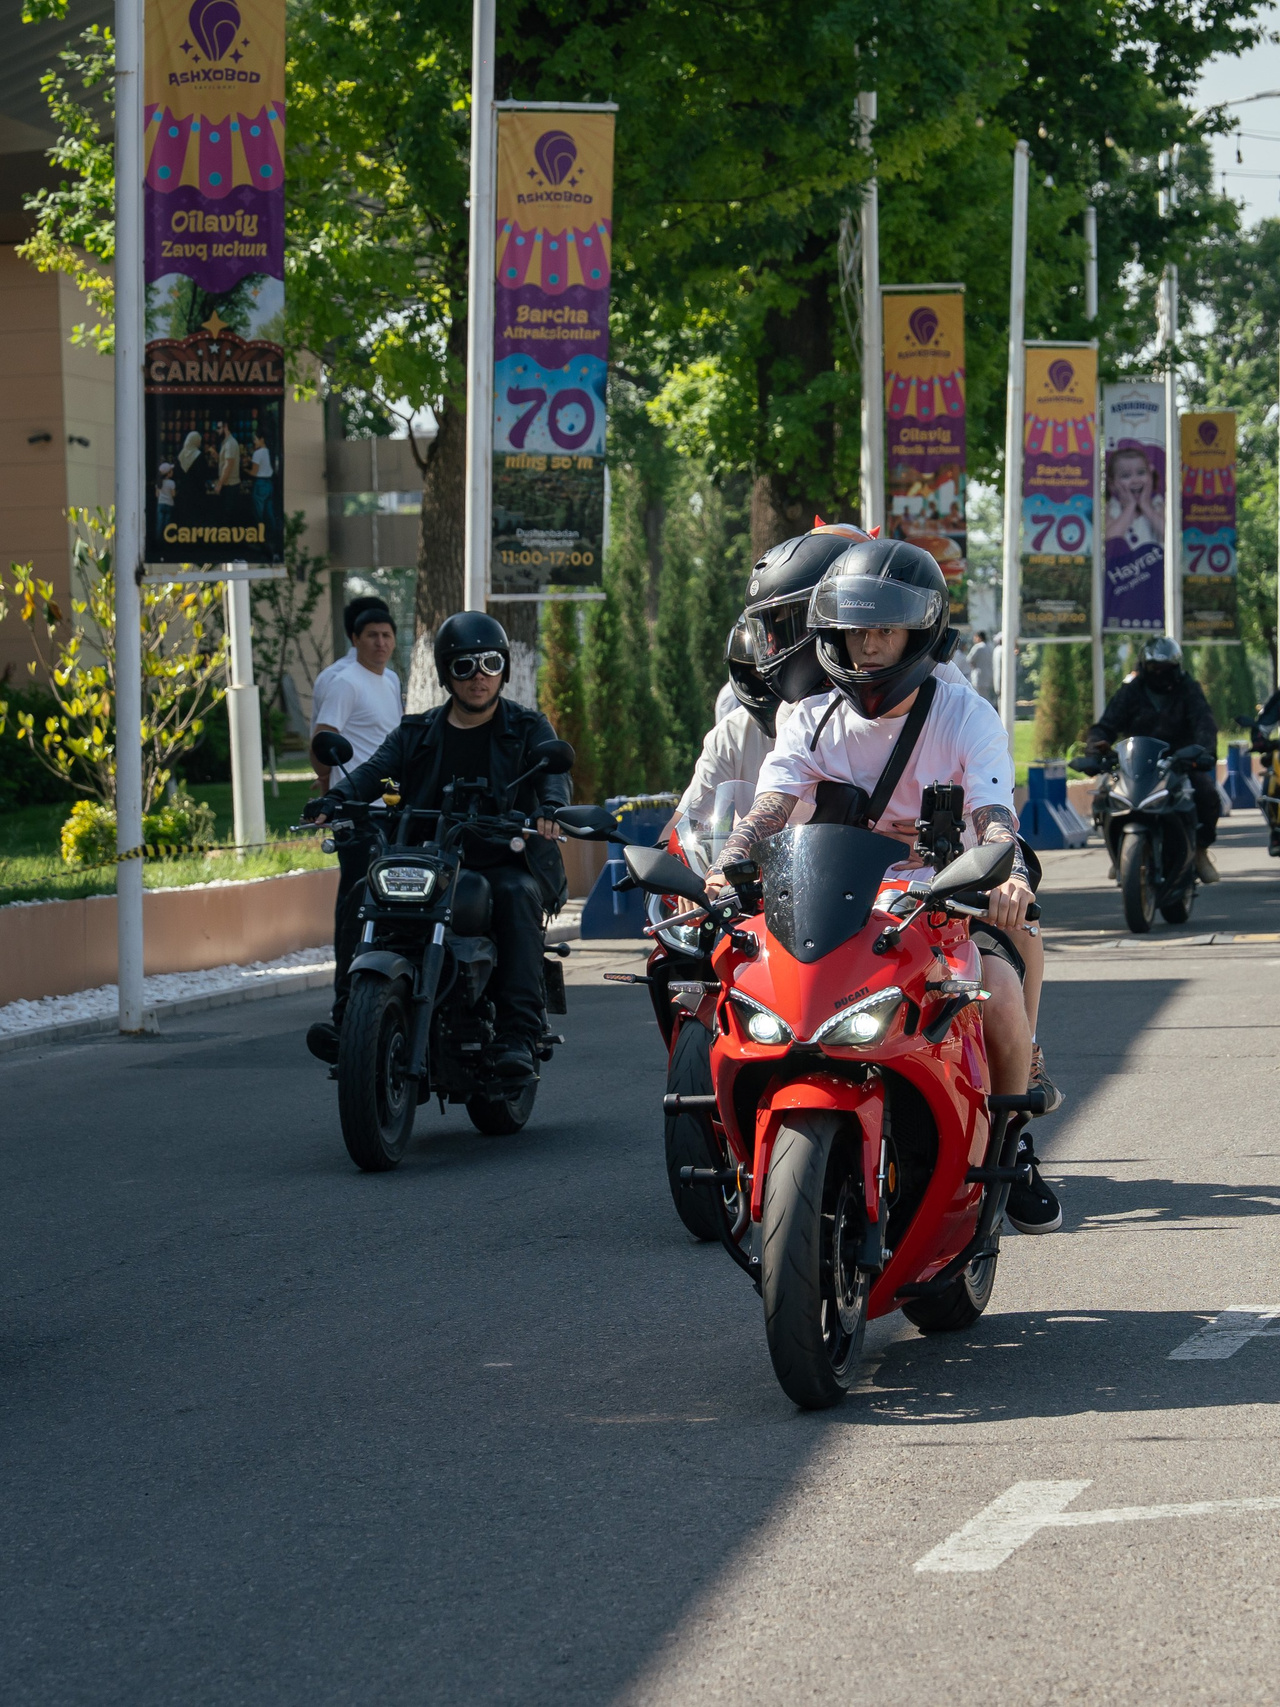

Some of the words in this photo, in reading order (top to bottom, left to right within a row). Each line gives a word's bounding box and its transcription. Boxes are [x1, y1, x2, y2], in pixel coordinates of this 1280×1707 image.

[171, 209, 259, 237] Oilaviy
[161, 240, 207, 261] Zavq
[212, 240, 267, 258] uchun
[516, 304, 589, 324] Barcha
[150, 360, 279, 382] CARNAVAL
[507, 386, 595, 450] 70
[163, 523, 265, 543] Carnaval
[1031, 514, 1086, 552] 70
[501, 550, 594, 566] 11:00-17:00
[1107, 547, 1163, 585] Hayrat
[1187, 544, 1231, 573] 70
[834, 986, 869, 1010] DUCATI
